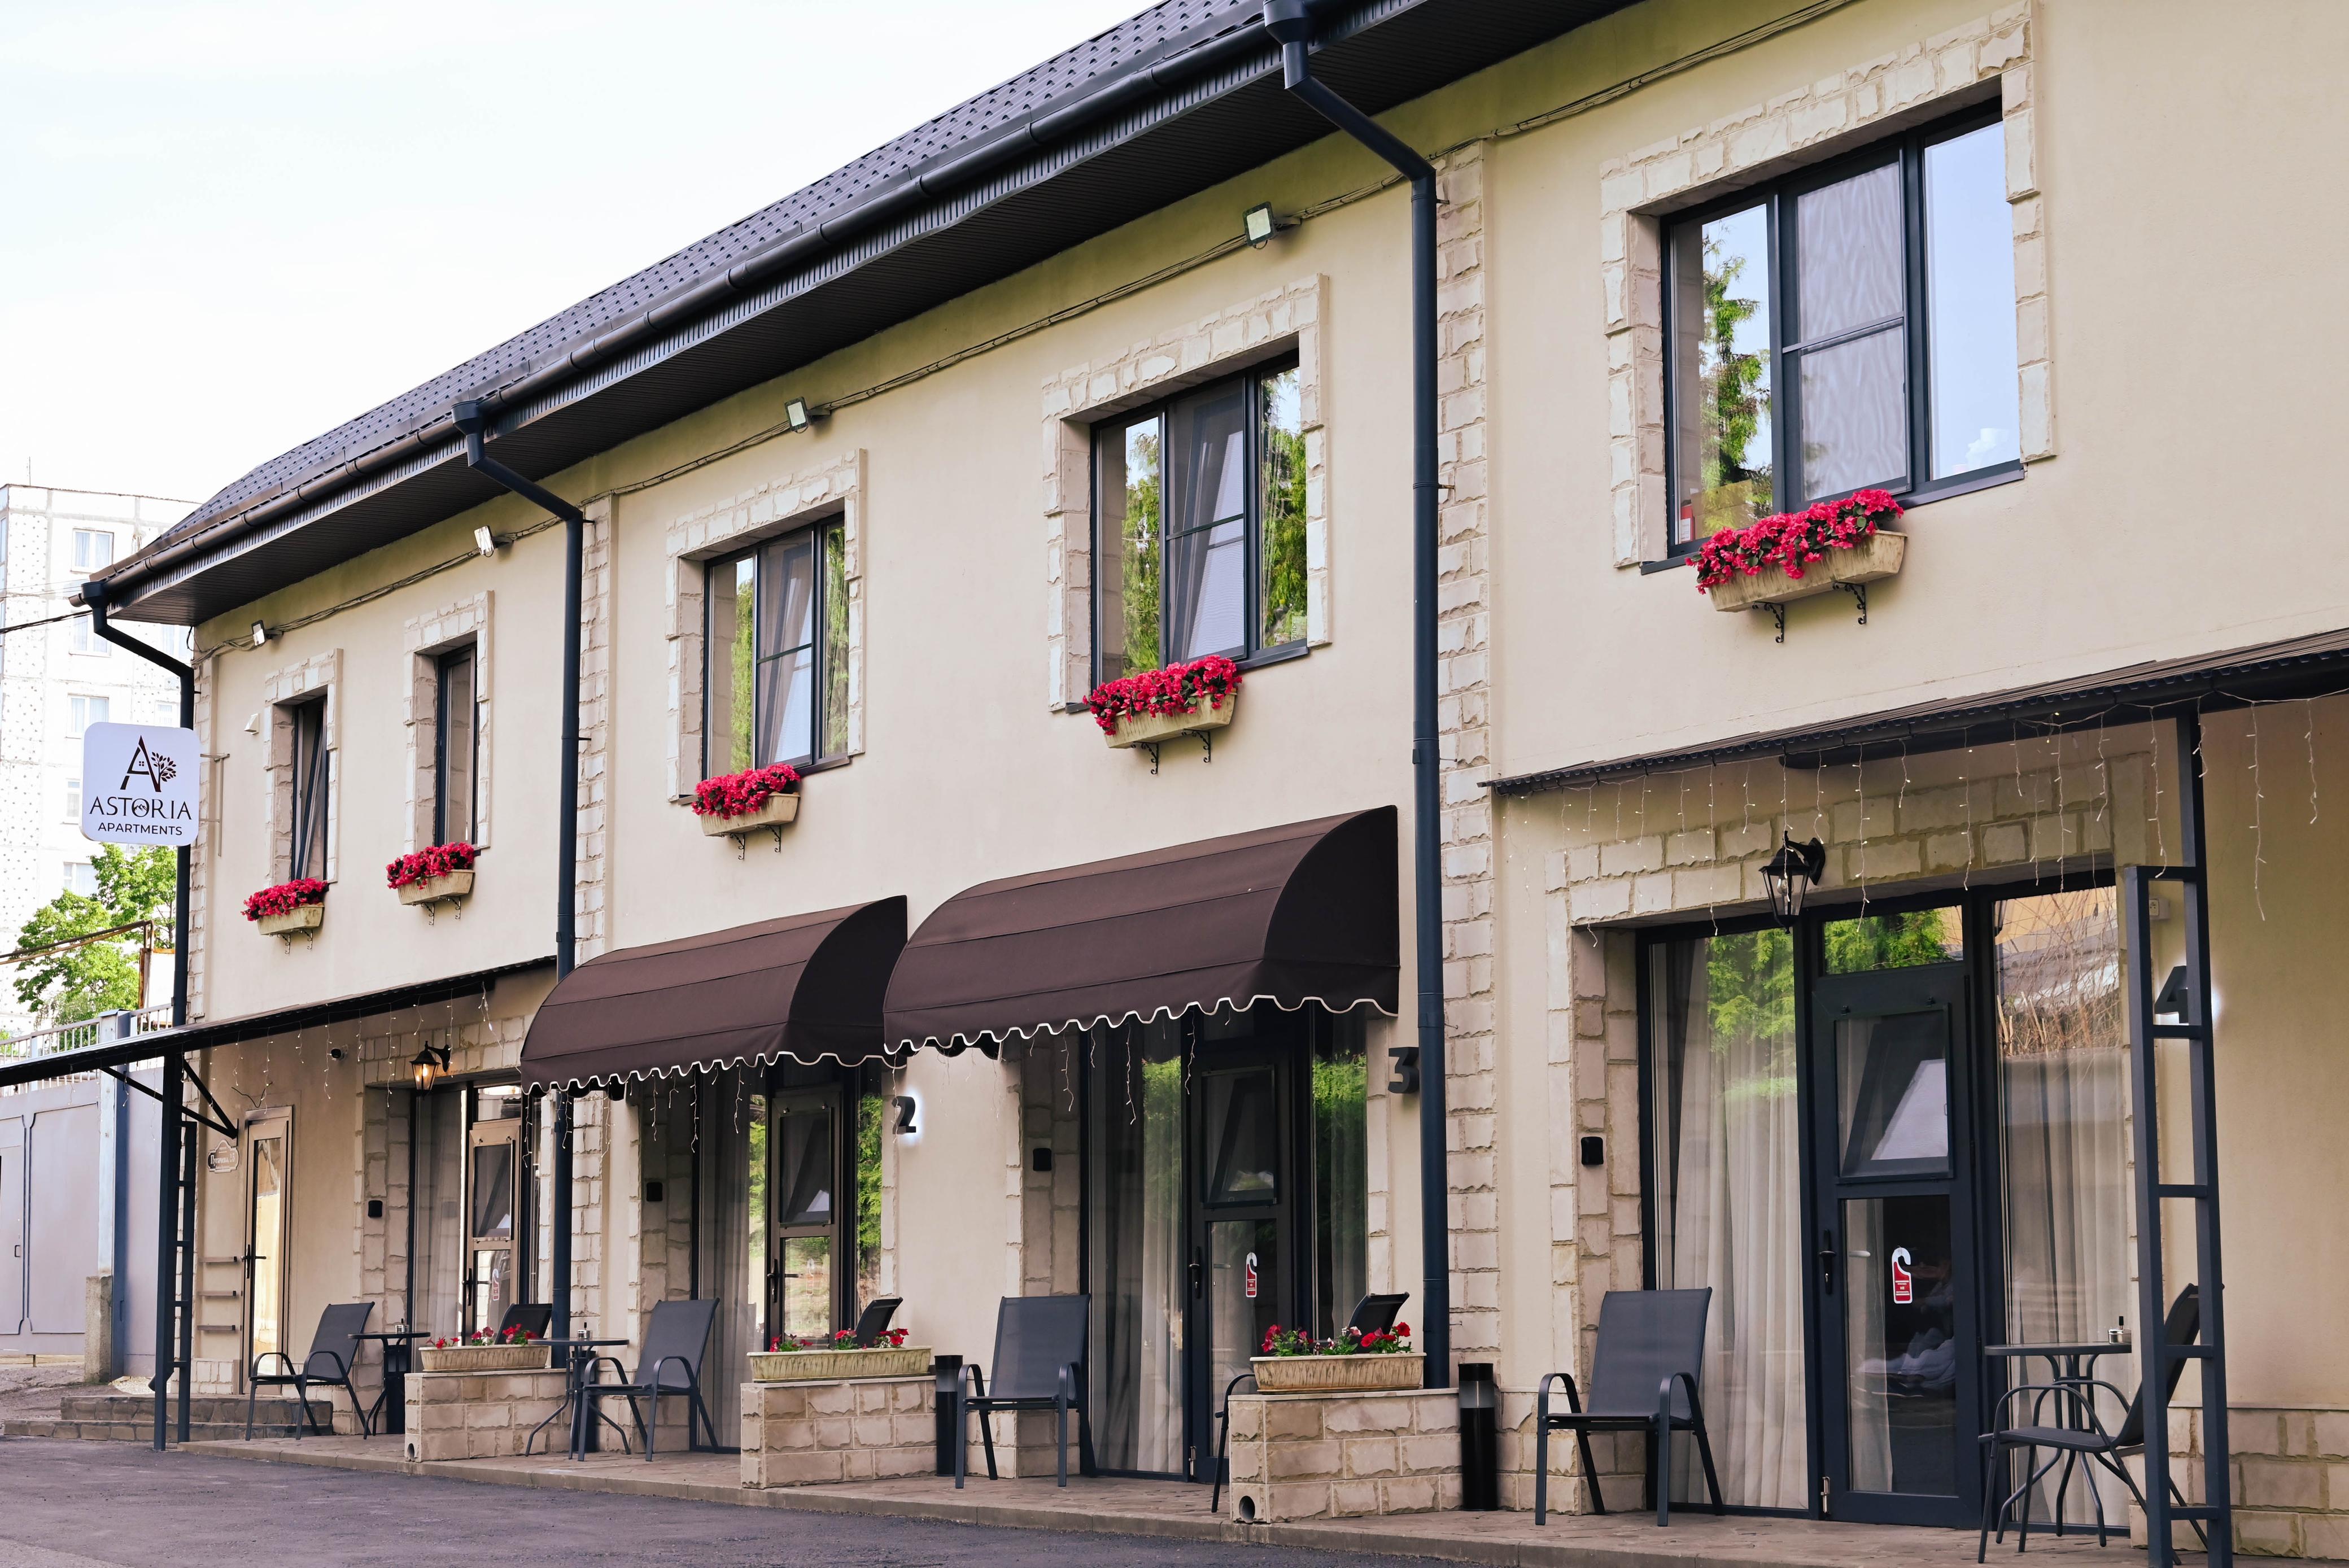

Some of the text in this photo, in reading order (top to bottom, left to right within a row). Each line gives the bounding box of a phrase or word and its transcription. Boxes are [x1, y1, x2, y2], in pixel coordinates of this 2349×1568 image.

[89, 796, 192, 820] ASTORIA
[98, 822, 182, 836] APARTMENTS
[2154, 965, 2189, 1024] 4
[1387, 1046, 1420, 1094] 3
[892, 1096, 916, 1134] 2
